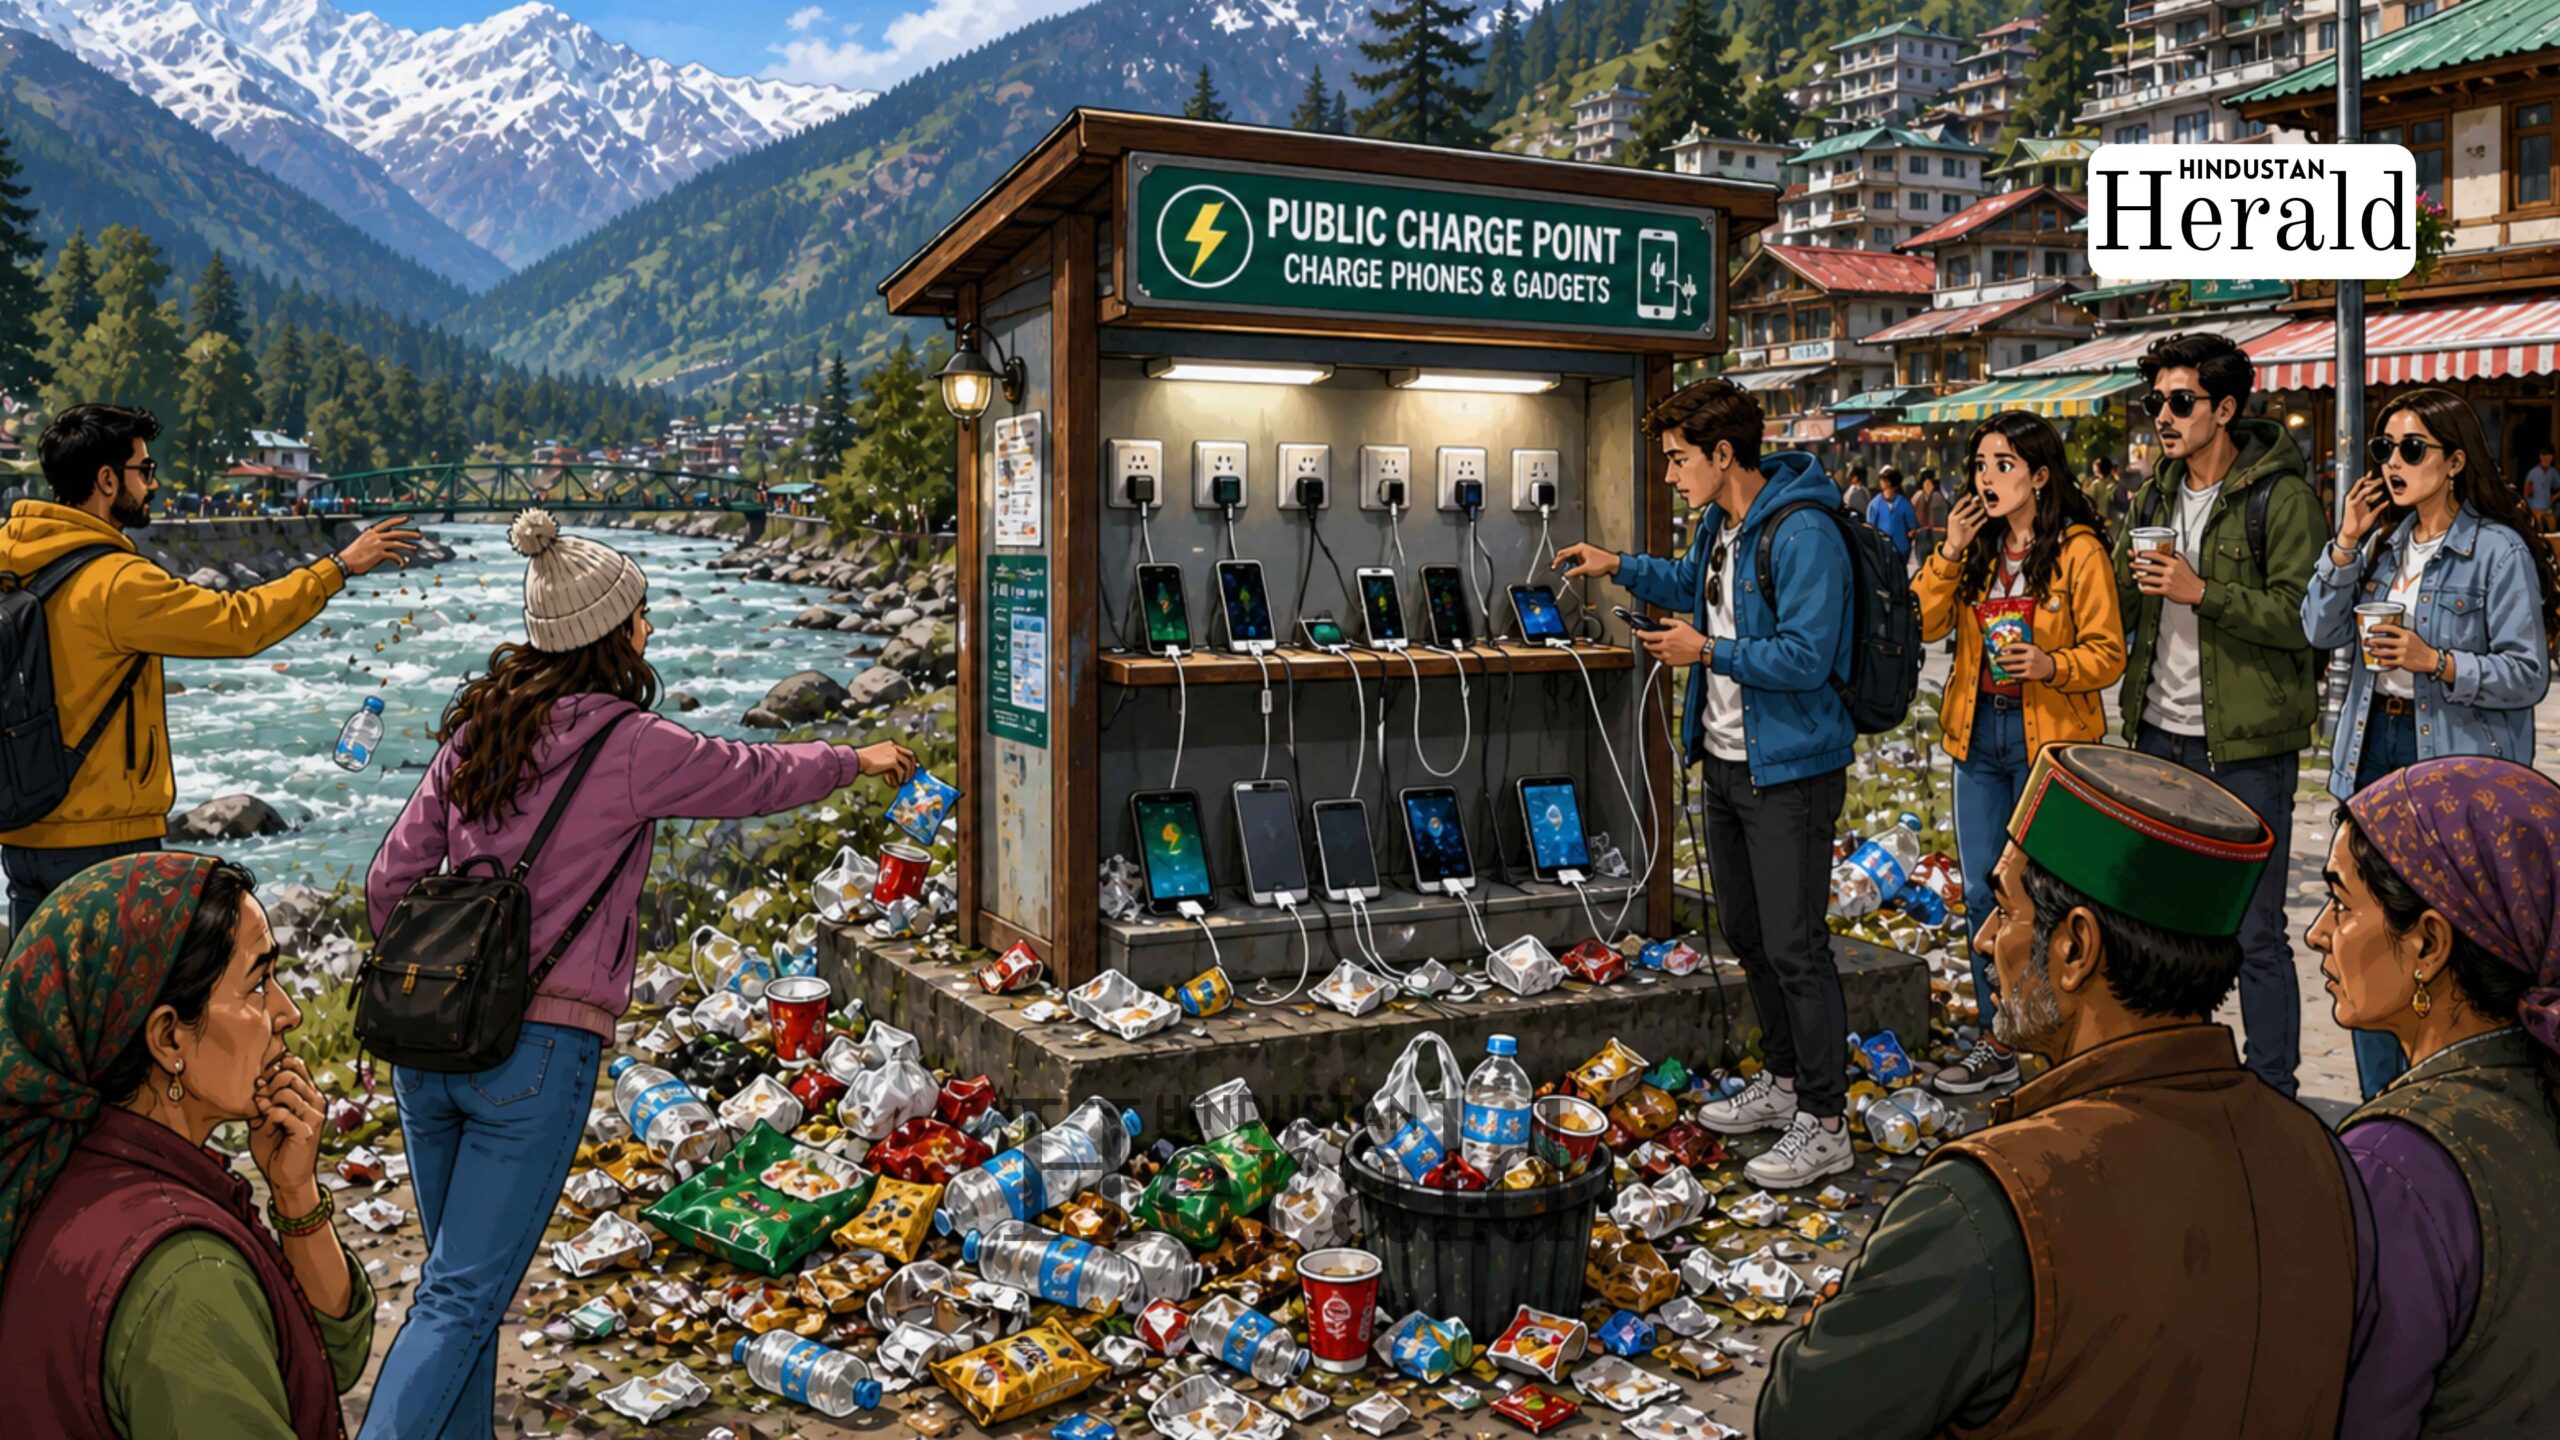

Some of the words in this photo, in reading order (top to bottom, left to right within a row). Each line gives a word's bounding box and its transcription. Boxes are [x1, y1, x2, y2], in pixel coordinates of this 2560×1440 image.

[1268, 197, 1387, 247] PUBLIC
[1397, 209, 1523, 257] CHARGE
[1533, 220, 1622, 265] POINT
[1284, 252, 1383, 289] CHARGE
[1391, 260, 1484, 295] PHONES
[1490, 268, 1507, 297] &
[1513, 269, 1610, 304] GADGETS
